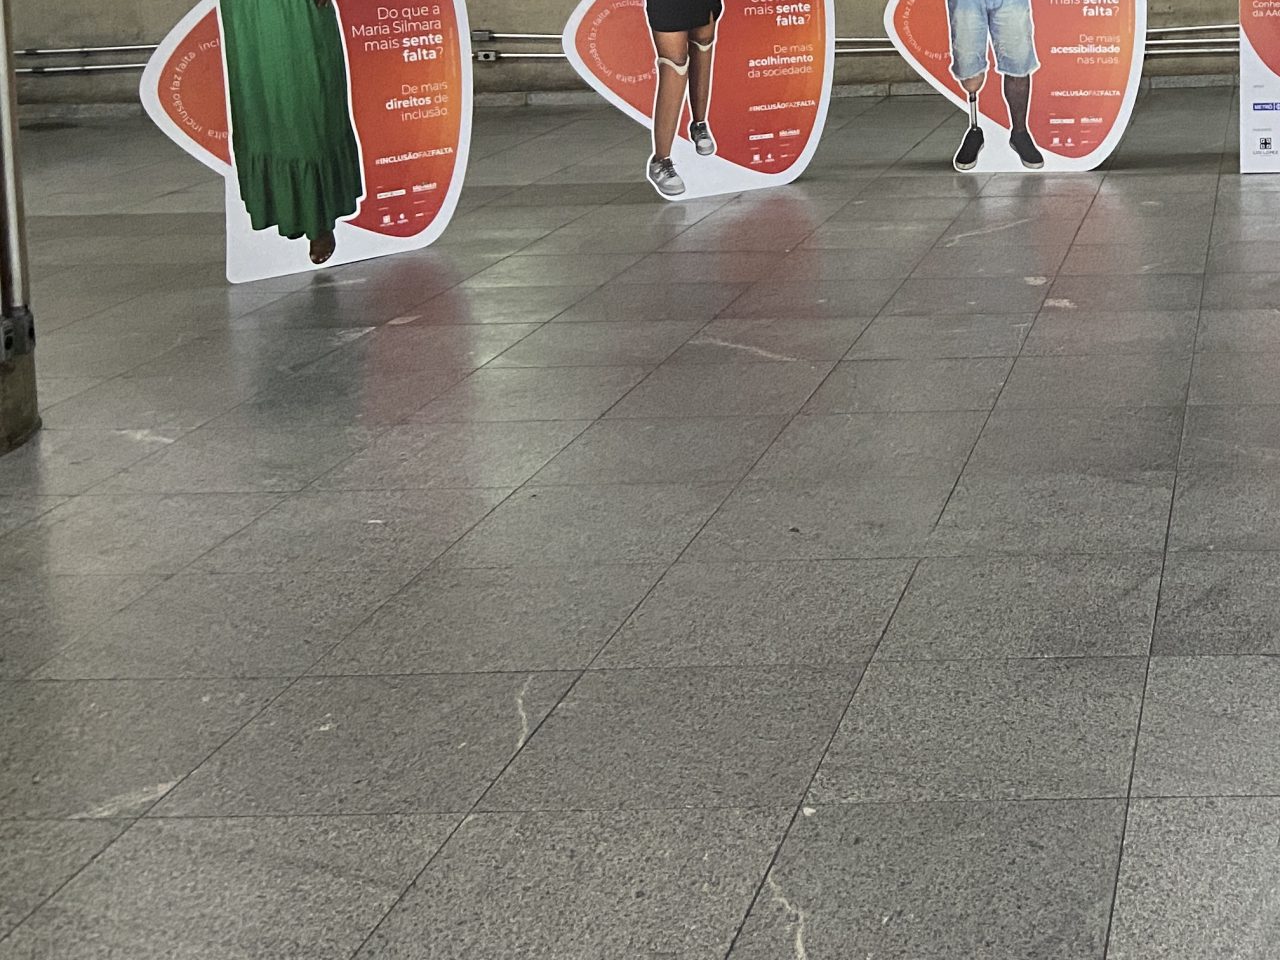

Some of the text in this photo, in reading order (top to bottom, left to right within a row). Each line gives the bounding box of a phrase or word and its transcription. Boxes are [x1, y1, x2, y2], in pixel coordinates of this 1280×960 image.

[377, 5, 440, 20] Do que a
[744, 2, 811, 16] mais sente
[1082, 6, 1120, 16] falta?
[776, 14, 811, 26] falta?
[352, 20, 442, 38] Maria Silmara
[364, 33, 443, 52] mais sente
[1080, 34, 1120, 43] De mais
[402, 47, 444, 62] falta?
[774, 44, 814, 54] De mais
[1050, 44, 1120, 54] acessibilidade
[748, 54, 814, 67] acolhimento
[1077, 56, 1094, 64] nas
[169, 74, 182, 91] faz
[176, 51, 196, 72] falta
[748, 68, 760, 78] da
[401, 82, 448, 95] De mais
[386, 93, 448, 110] direitos de
